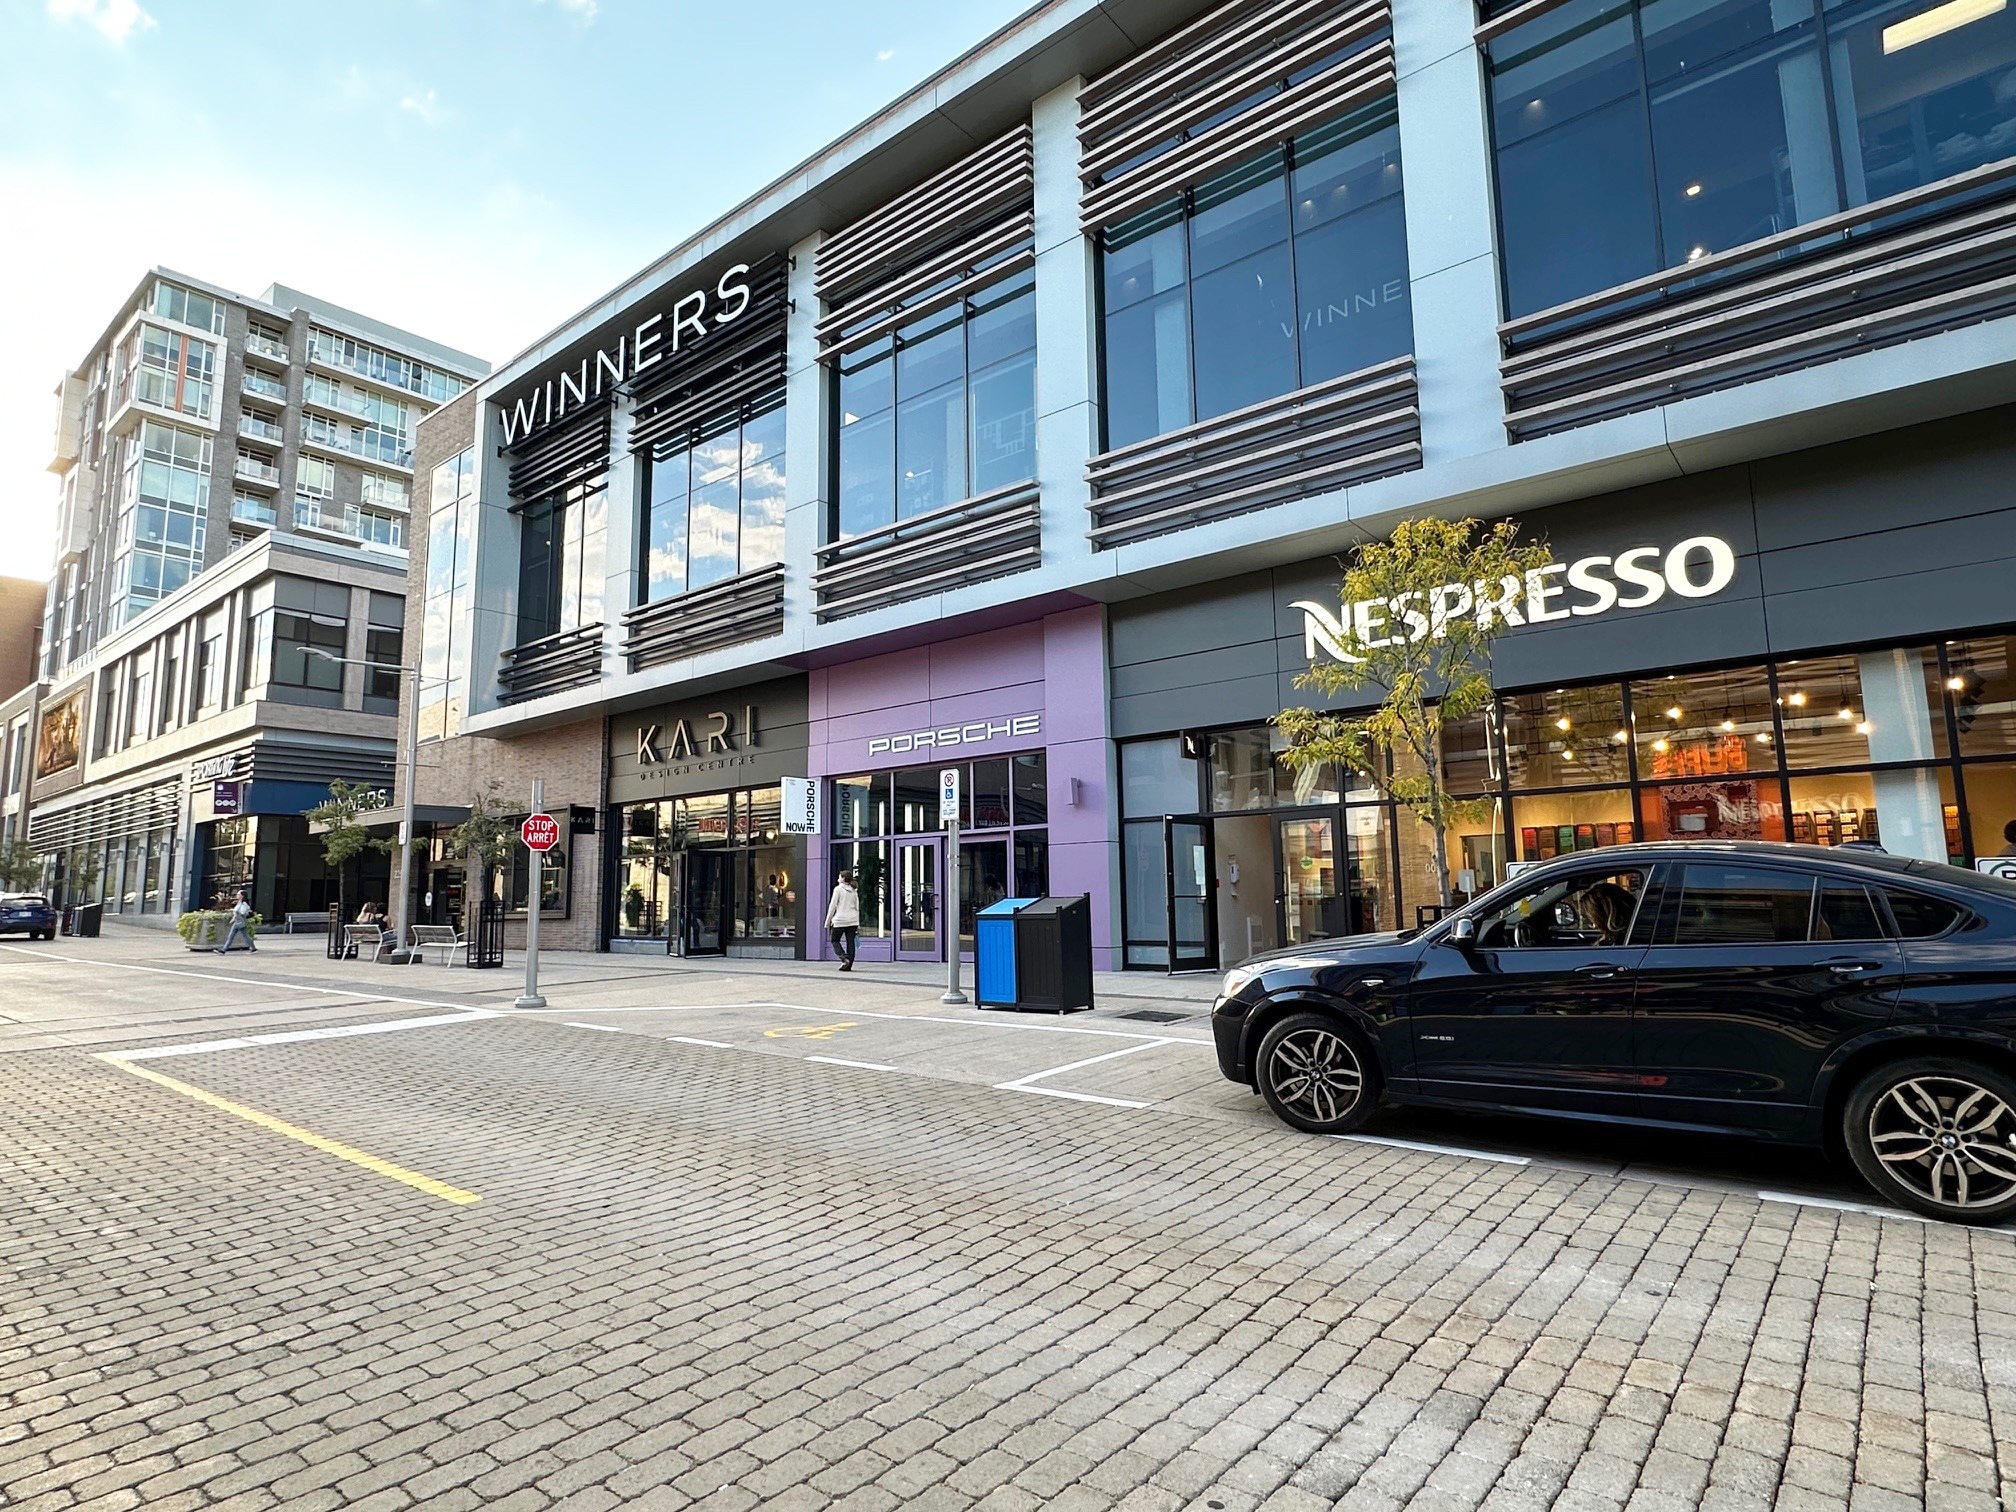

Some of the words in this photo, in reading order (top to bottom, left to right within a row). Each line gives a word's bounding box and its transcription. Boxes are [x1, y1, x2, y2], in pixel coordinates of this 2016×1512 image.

[501, 263, 751, 446] WINNERS
[1287, 536, 1736, 663] NESPRESSO
[637, 705, 752, 764] KARI
[869, 714, 1041, 757] PORSCHE
[640, 766, 690, 780] DESIGN
[698, 755, 756, 773] CENTRE
[570, 816, 595, 824] KARI
[806, 780, 816, 833] PORSCHE
[526, 831, 555, 843] ARRÊT
[528, 820, 554, 831] STOP
[785, 822, 806, 833] NOW
